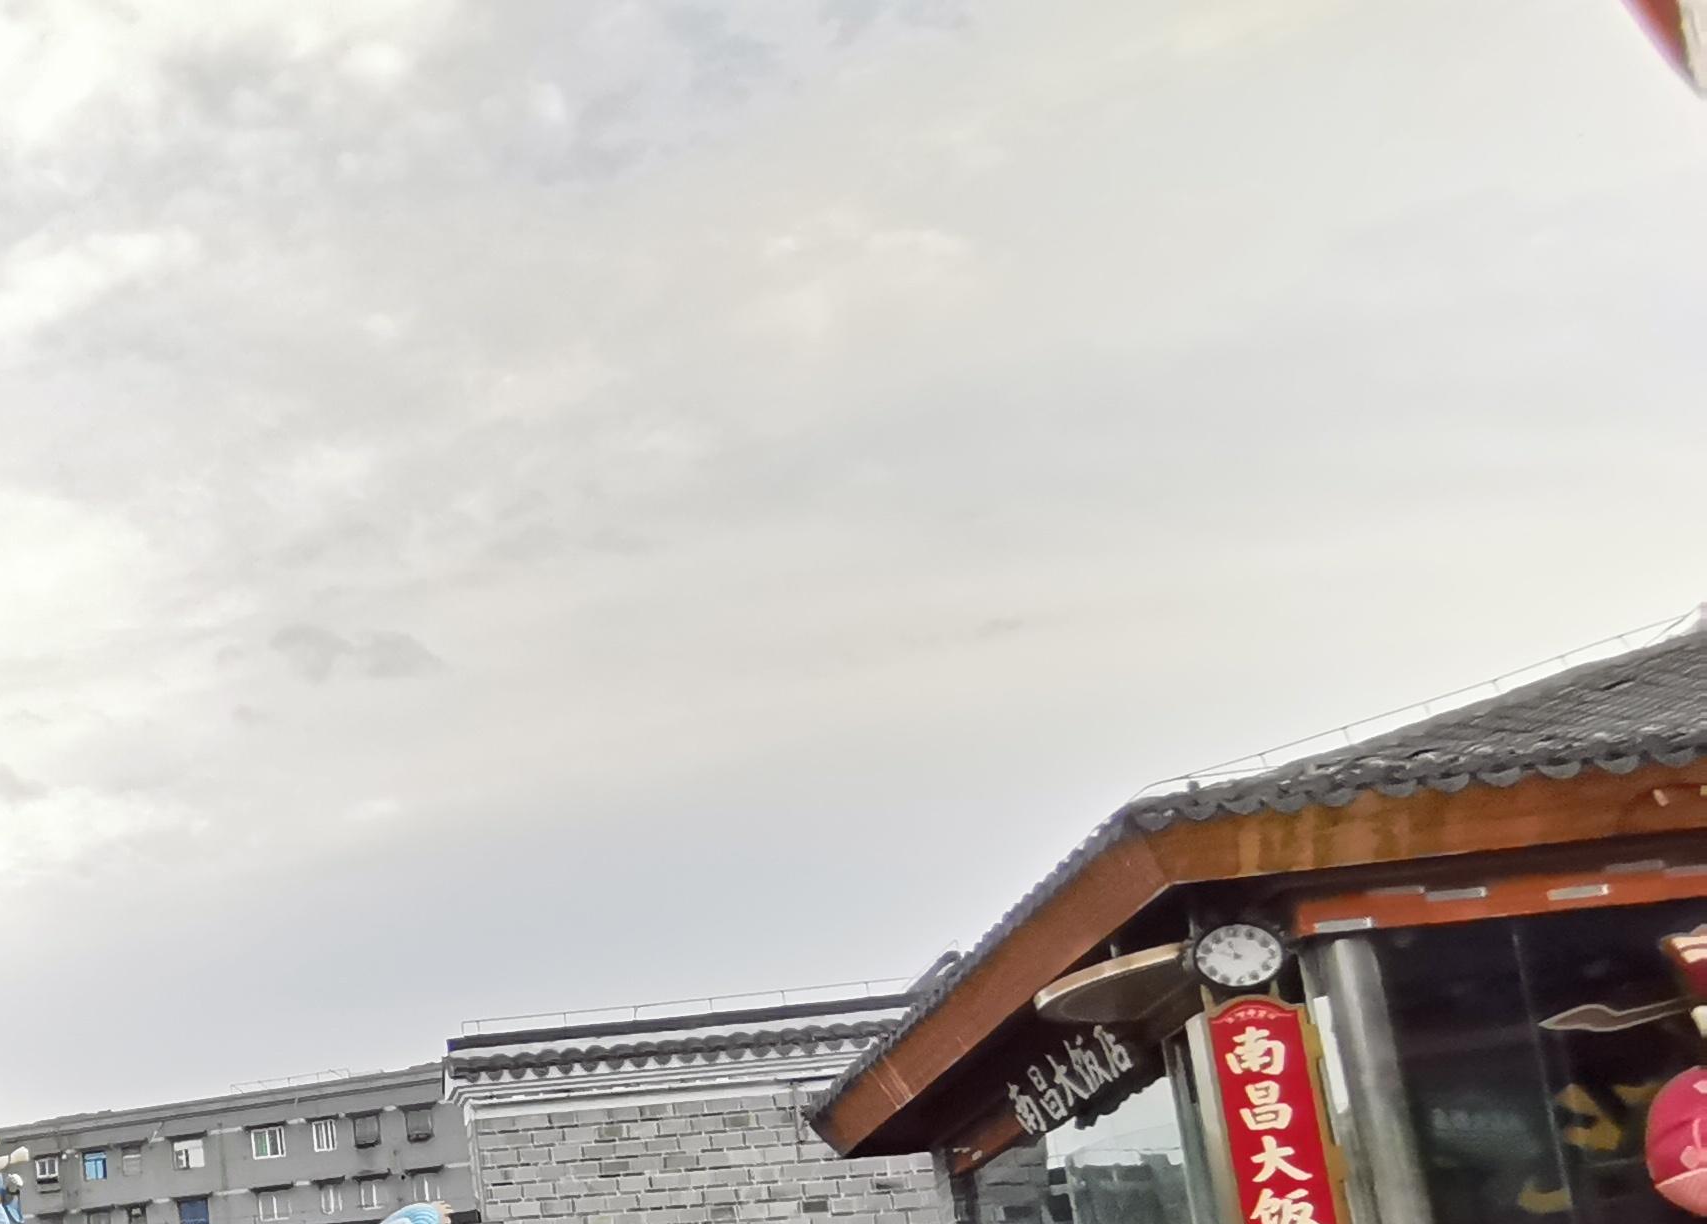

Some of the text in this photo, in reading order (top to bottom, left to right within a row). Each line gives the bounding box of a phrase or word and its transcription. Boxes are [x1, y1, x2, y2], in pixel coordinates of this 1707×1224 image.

[1007, 1025, 1134, 1135] 南昌大饭店
